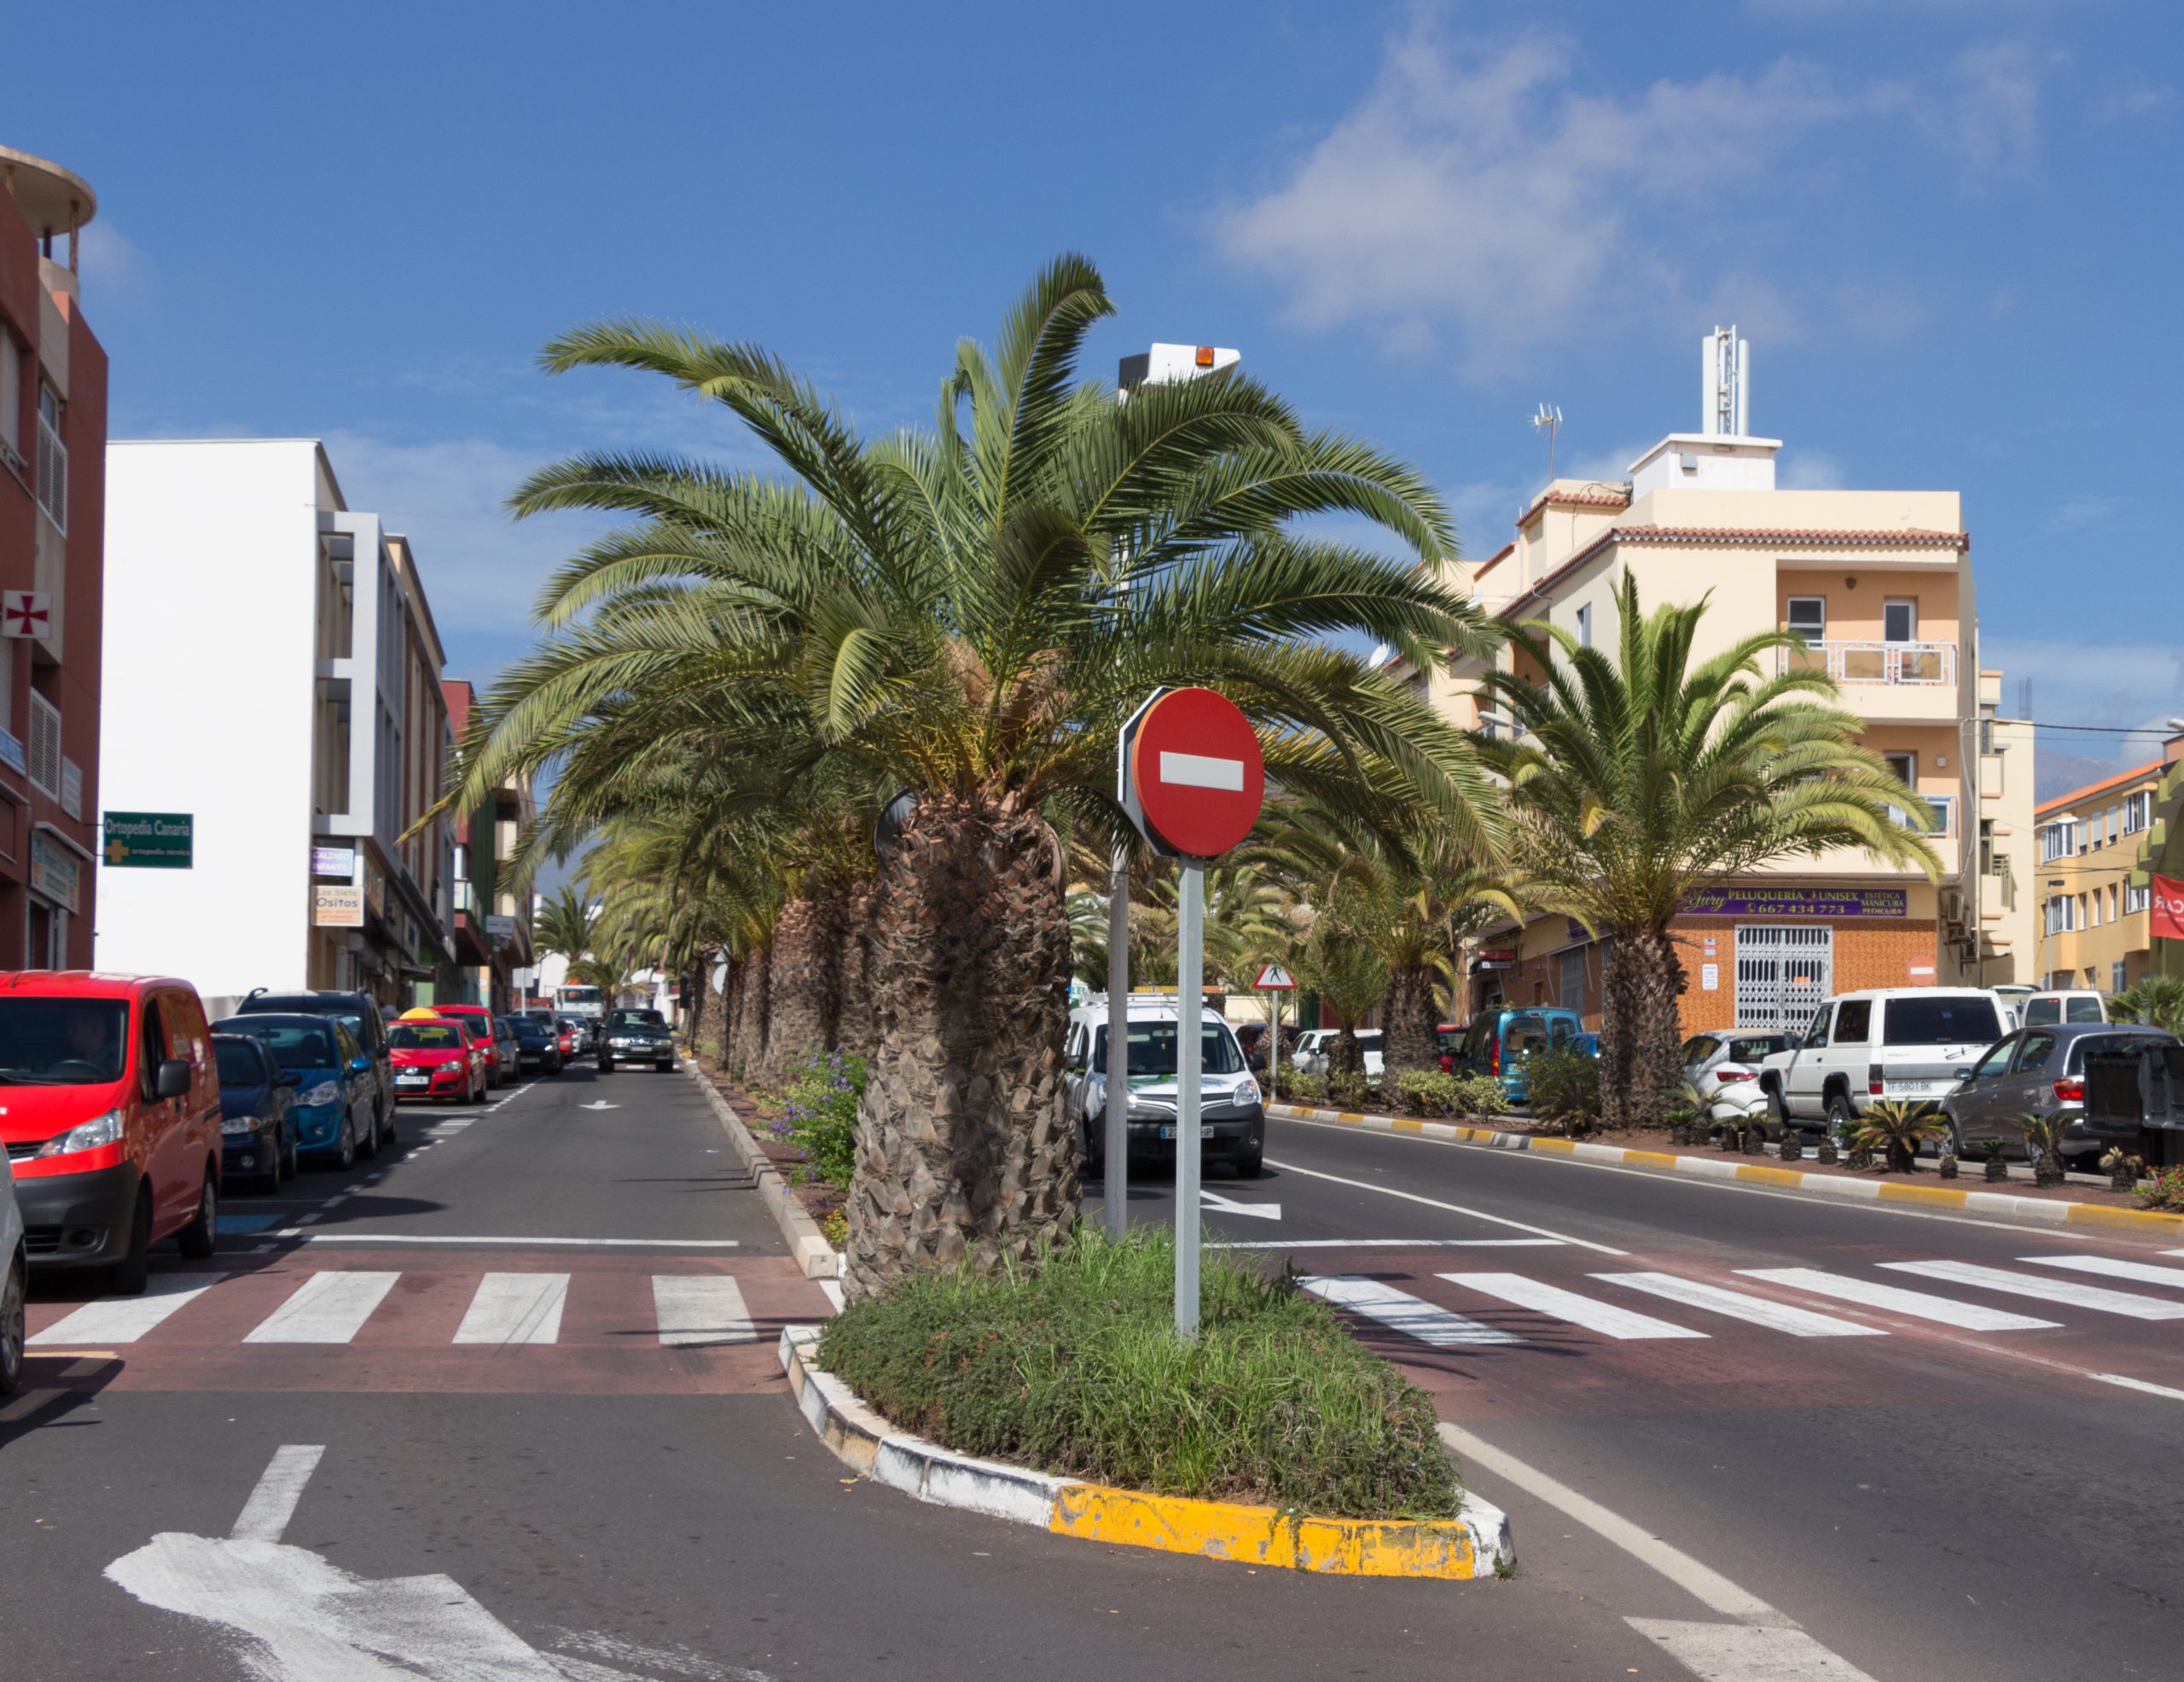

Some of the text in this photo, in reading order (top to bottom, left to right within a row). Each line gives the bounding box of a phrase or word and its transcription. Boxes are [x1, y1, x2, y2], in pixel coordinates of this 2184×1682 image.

[105, 819, 189, 839] Ortopedia Canaria
[1819, 891, 1858, 902] UNISEX
[317, 897, 358, 908] Ositos
[1758, 905, 1845, 914] 667 434 773
